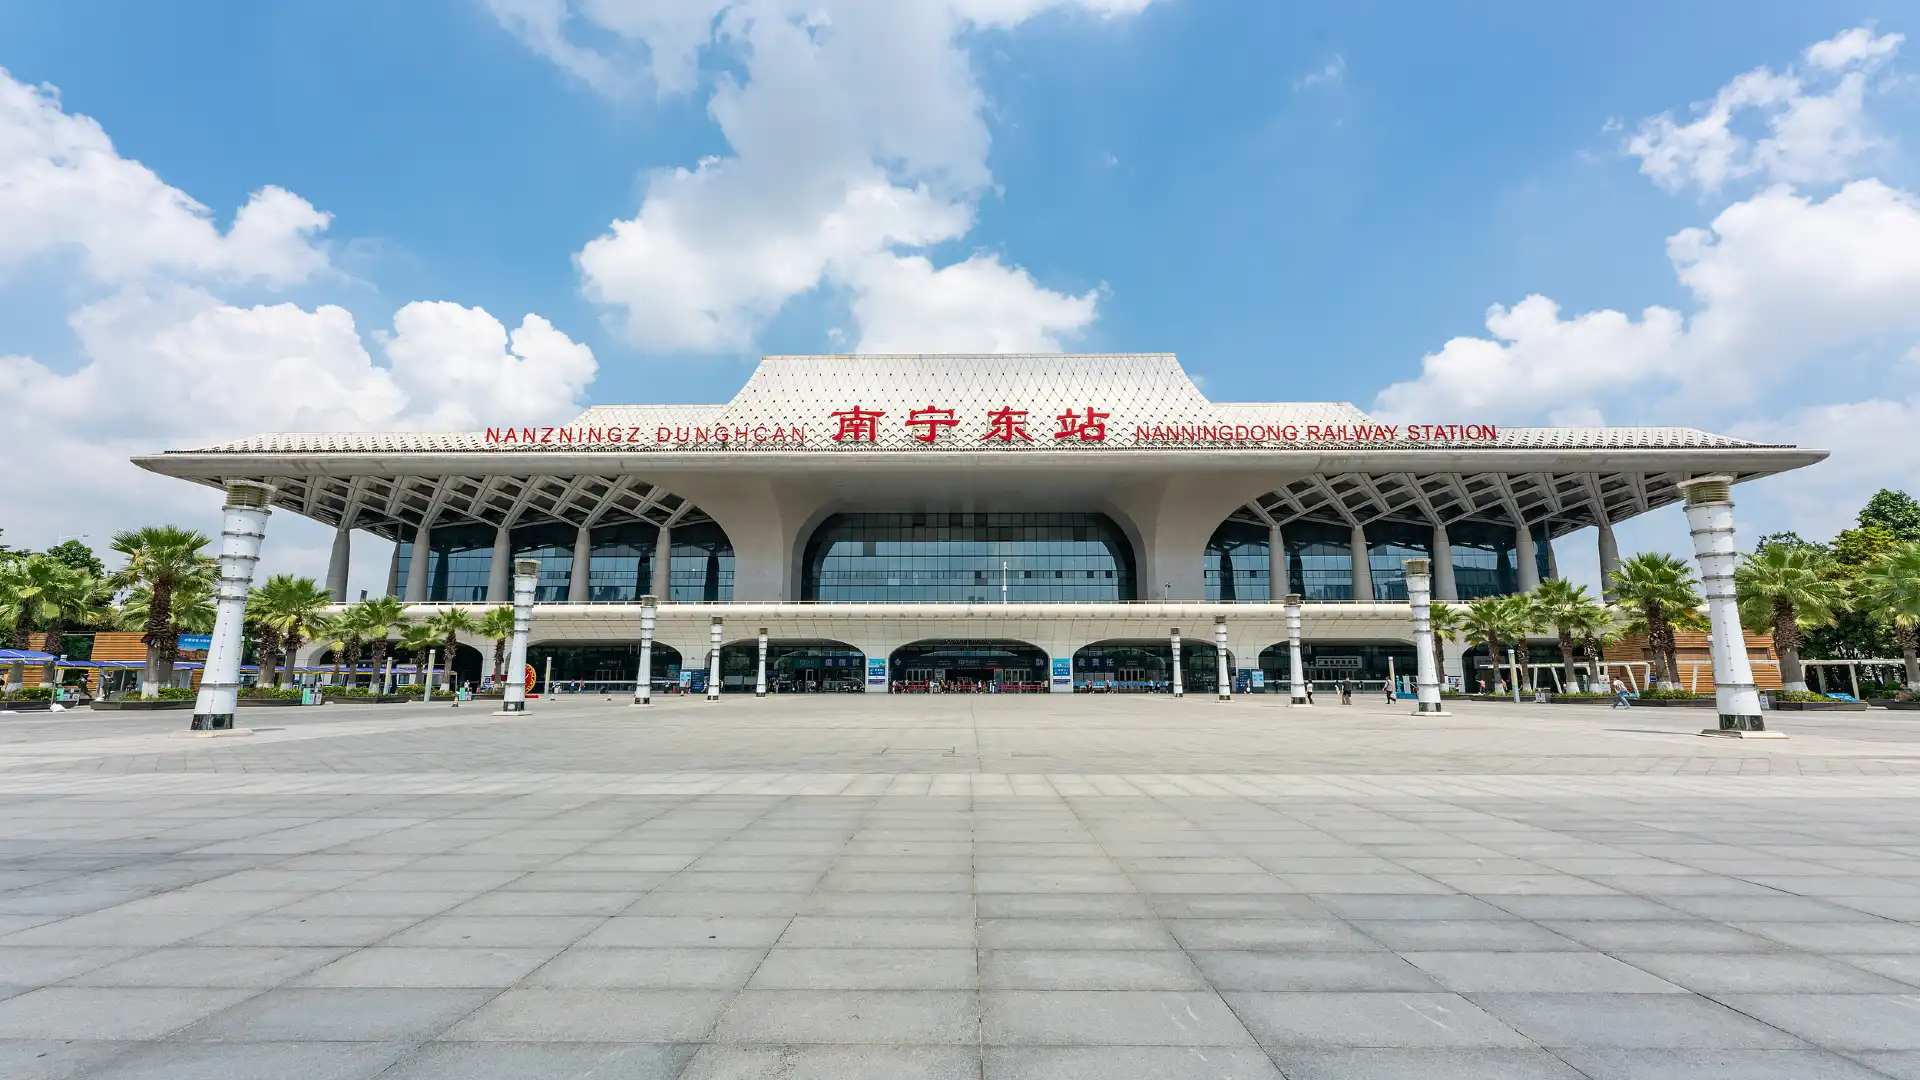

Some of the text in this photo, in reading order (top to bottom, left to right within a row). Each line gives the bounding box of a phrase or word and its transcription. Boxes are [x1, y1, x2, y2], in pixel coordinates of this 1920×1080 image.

[830, 404, 1111, 442] 南宁东站
[485, 426, 806, 443] NANZNINGZ DUNGHCAN
[1135, 424, 1497, 441] NANNINGDONG RAILWAY STATION
